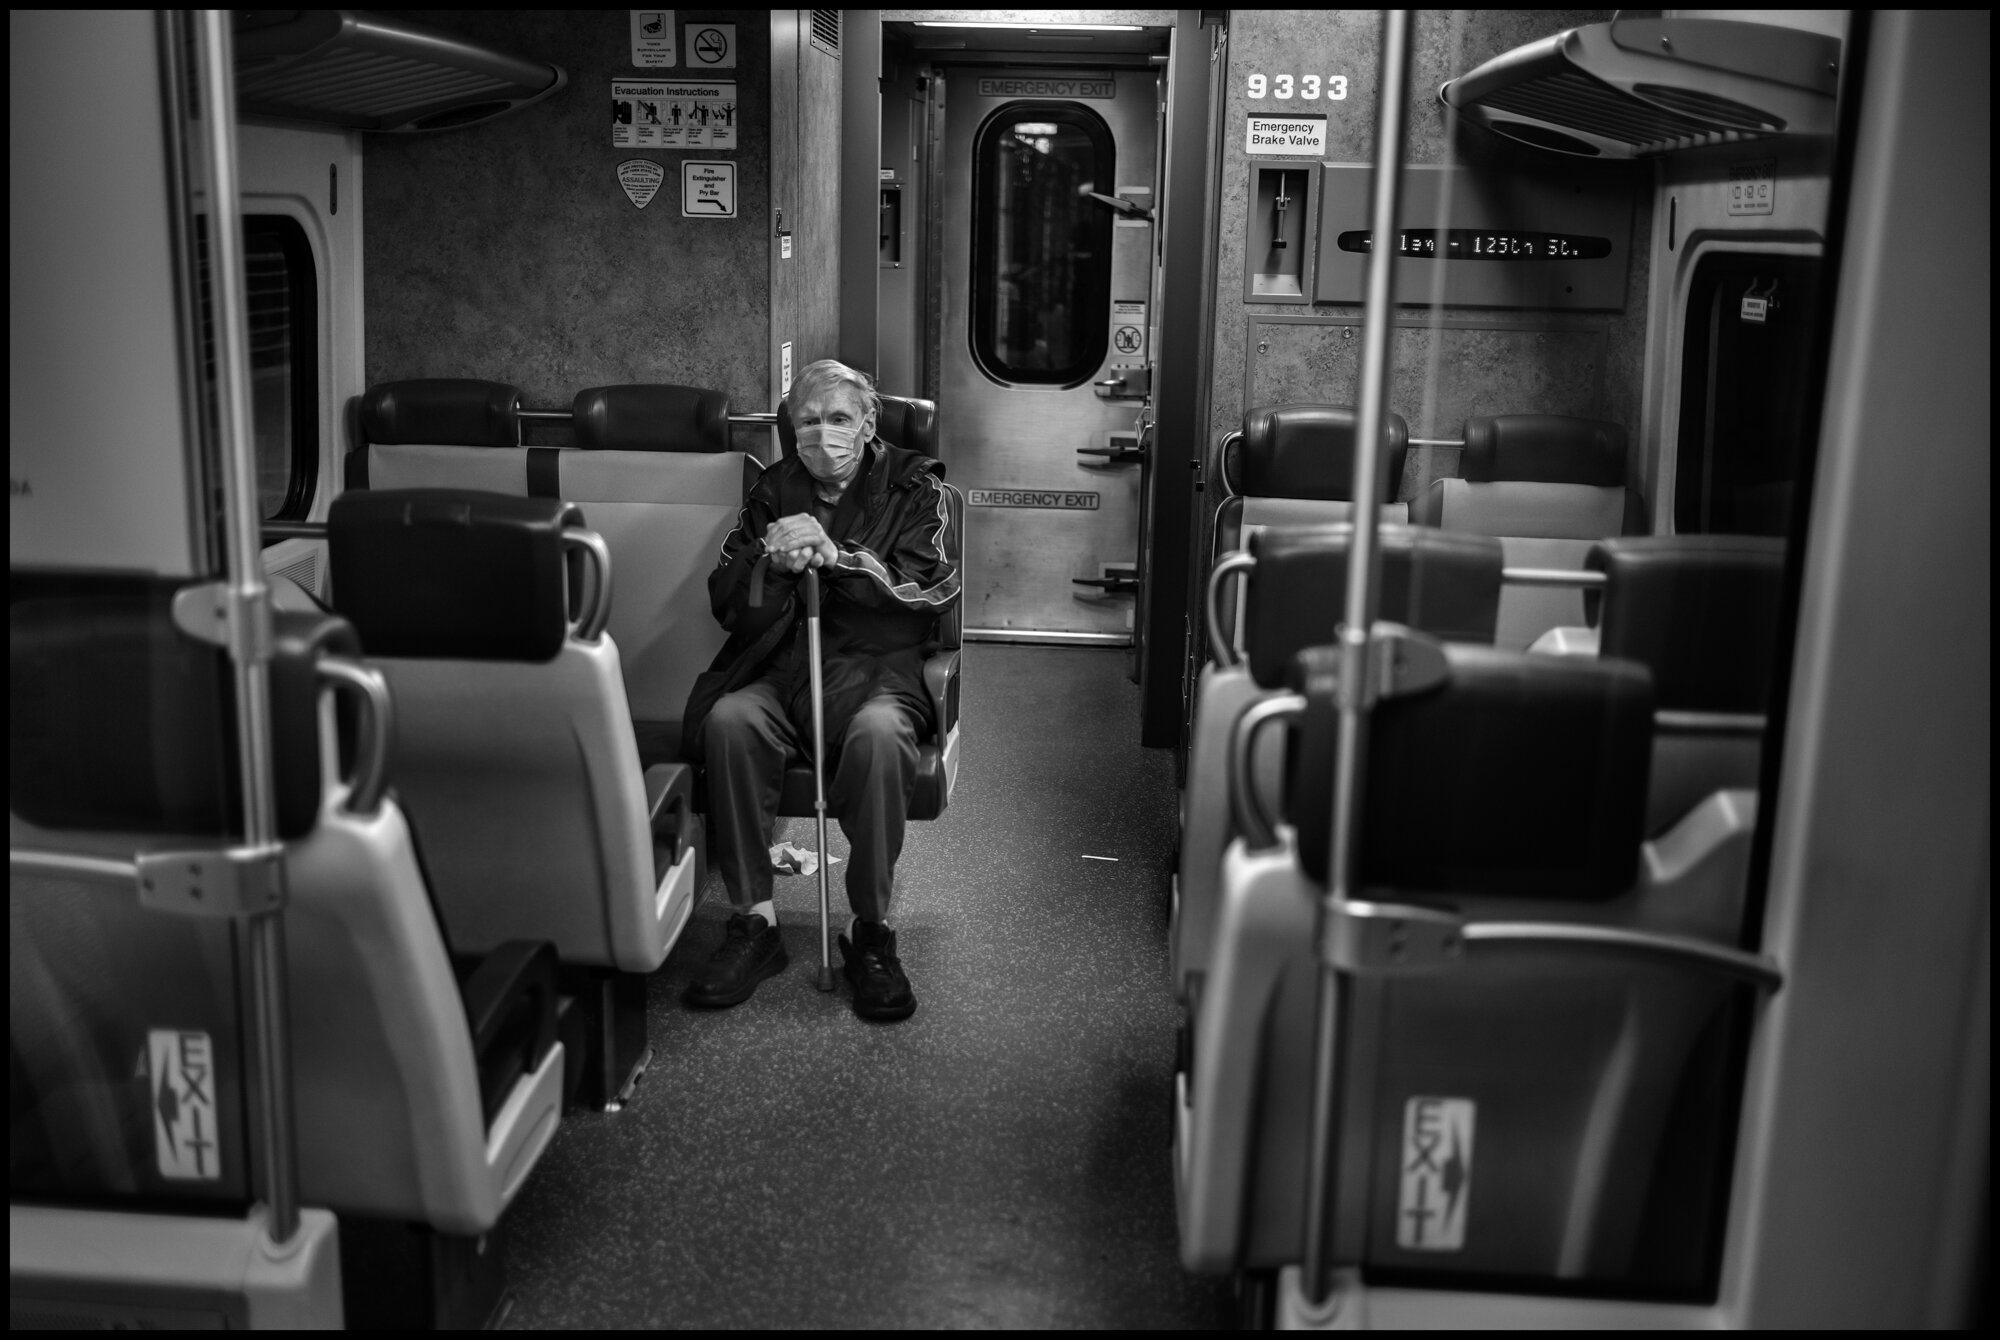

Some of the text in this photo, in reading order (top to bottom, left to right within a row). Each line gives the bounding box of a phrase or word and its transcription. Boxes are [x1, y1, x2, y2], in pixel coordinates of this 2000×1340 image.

[614, 86, 720, 97] Evacuation Instructions
[981, 81, 1112, 96] EMERGENCY EXIT
[1247, 74, 1348, 100] 9333
[1253, 121, 1314, 134] Emergency
[1252, 134, 1320, 146] Brake Valve
[1474, 237, 1533, 254] 125th
[1548, 240, 1578, 256] St.
[971, 491, 1096, 507] EMERGENCY EXIT
[180, 1032, 213, 1176] EXIT
[1405, 1098, 1441, 1245] EXIT
